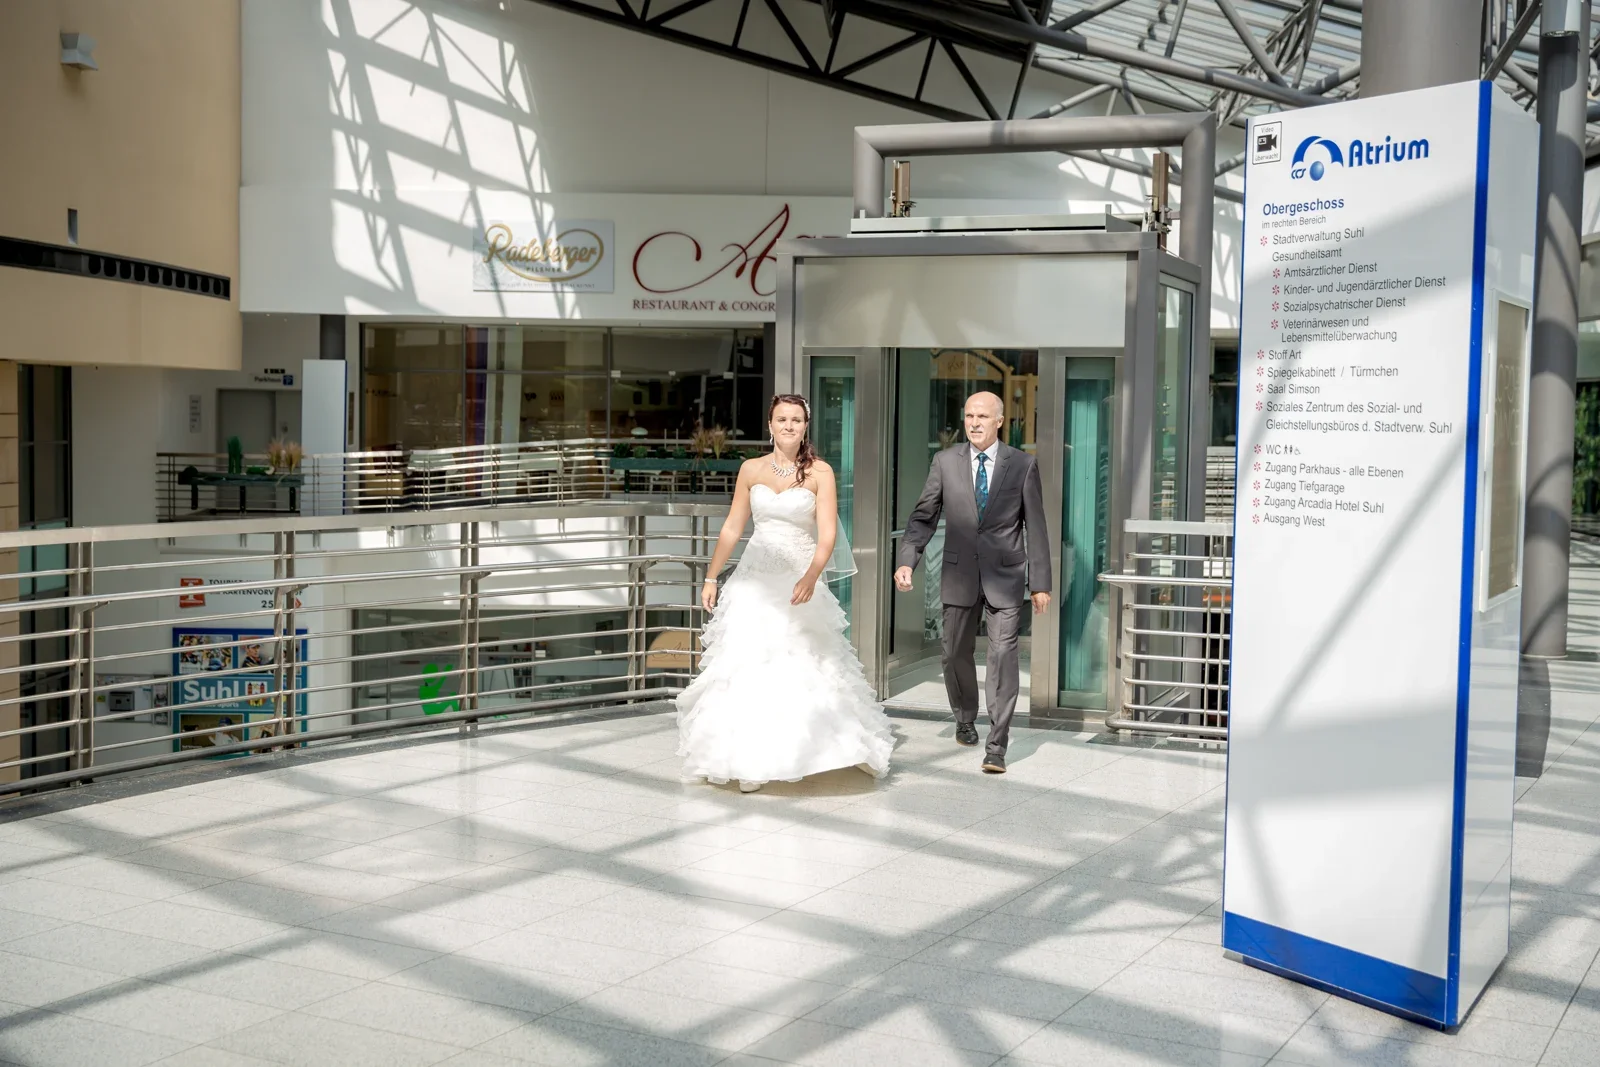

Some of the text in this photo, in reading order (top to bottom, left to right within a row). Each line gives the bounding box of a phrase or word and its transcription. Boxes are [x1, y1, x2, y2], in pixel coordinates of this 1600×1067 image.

[1261, 126, 1274, 134] Video
[1348, 135, 1429, 168] Atrium
[1263, 198, 1344, 217] Obergeschoss
[1262, 215, 1326, 229] im rechten Bereich
[1272, 227, 1364, 245] Stadtverwaltung Suhl
[1272, 248, 1342, 263] Gesundheitsamt
[1284, 262, 1377, 279] Amtsärztlicher Dienst
[1283, 276, 1446, 295] Kinder- und Jugendärztlicher Dienst
[633, 299, 776, 312] RESTAURANT & CONGR
[1376, 297, 1406, 308] Dienst
[1282, 317, 1369, 330] Veterinärwesen und
[1281, 330, 1397, 343] Lebensmittelüberwachung
[1268, 349, 1302, 360] Stoff Art
[1267, 366, 1336, 380] Spiegelkabinett
[1350, 365, 1398, 378] Türmchen
[1267, 384, 1320, 394] Saal Simson
[1267, 401, 1422, 414] Soziales Zentrum des Sozial- und
[1266, 419, 1452, 434] Gleichstellungsbüros d. Stadtverw. Suhl
[1266, 444, 1282, 455] WC
[1265, 462, 1297, 475] Zugang
[1300, 464, 1340, 475] Parkhaus
[1349, 466, 1365, 476] alle
[1368, 466, 1403, 478] Ebenen
[1265, 479, 1345, 495] Zugang Tiefgarage
[1264, 496, 1384, 513] Zugang Arcadia Hotel Suhl
[1264, 513, 1325, 527] Ausgang West
[261, 600, 274, 608] 25
[184, 680, 239, 701] Suhl
